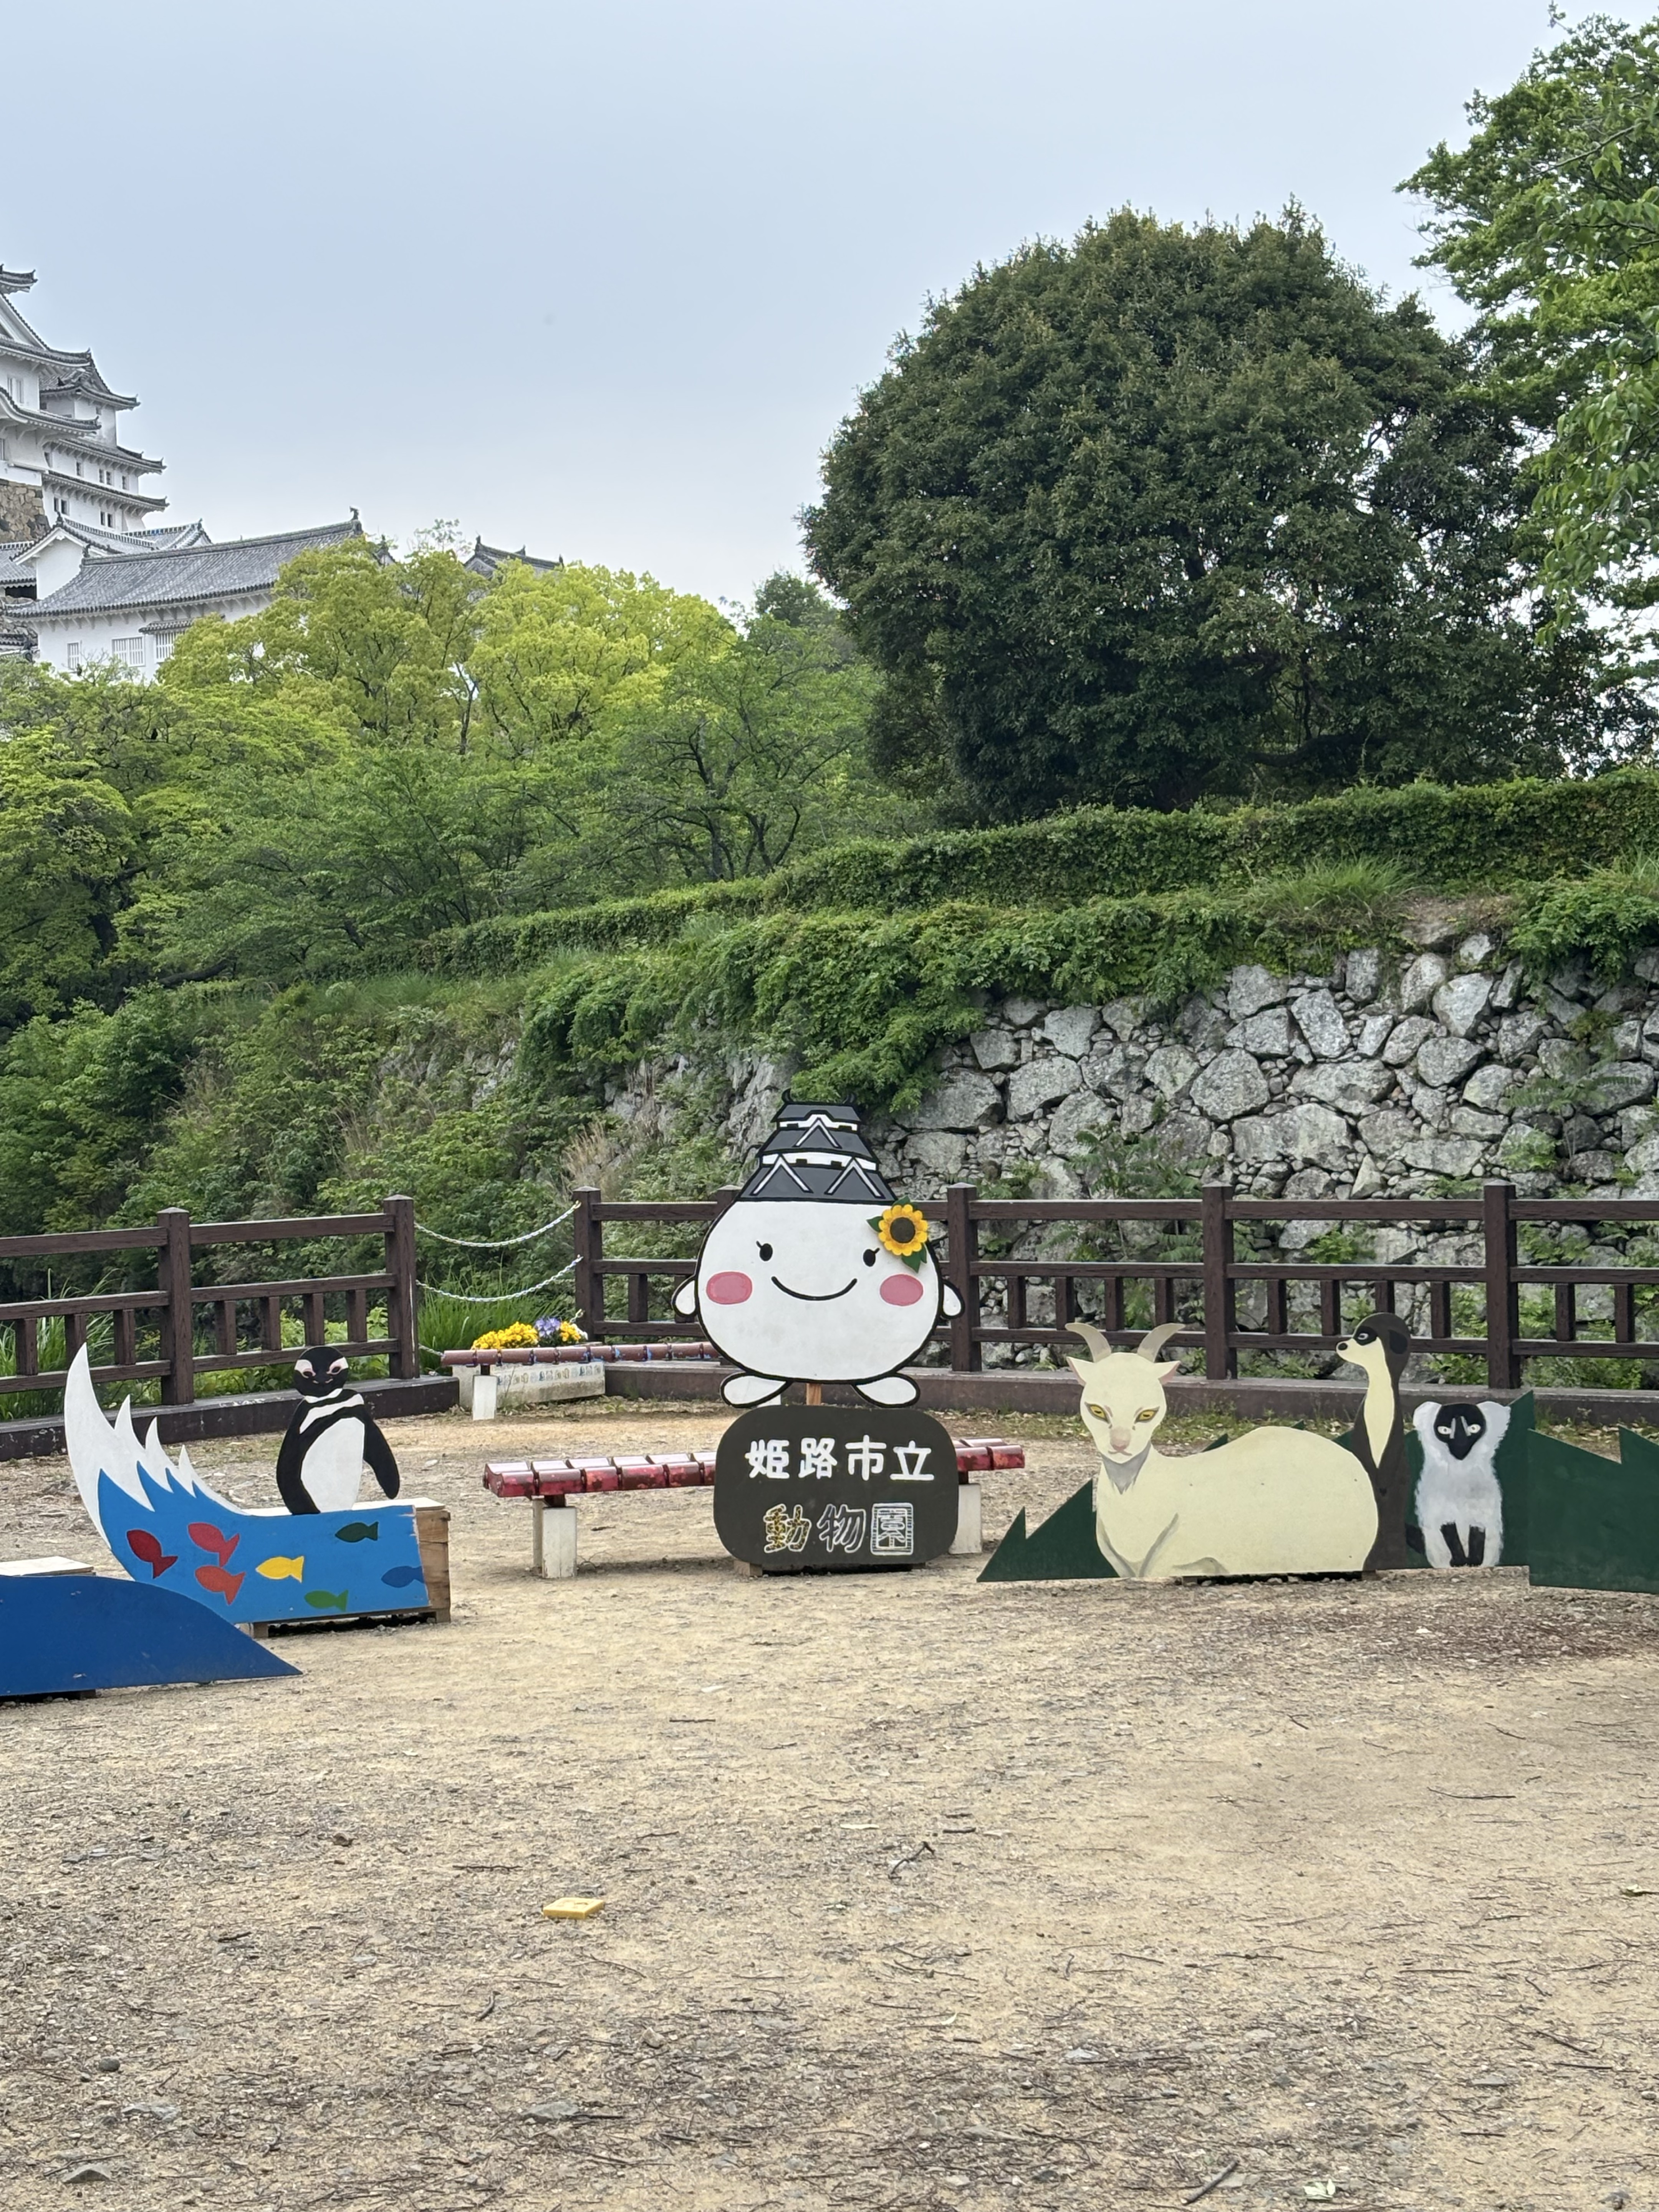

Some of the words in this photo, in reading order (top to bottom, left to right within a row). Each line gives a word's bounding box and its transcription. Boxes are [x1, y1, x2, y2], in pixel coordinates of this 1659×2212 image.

[745, 1435, 934, 1481] 姫路市立
[763, 1502, 914, 1556] 動物園
